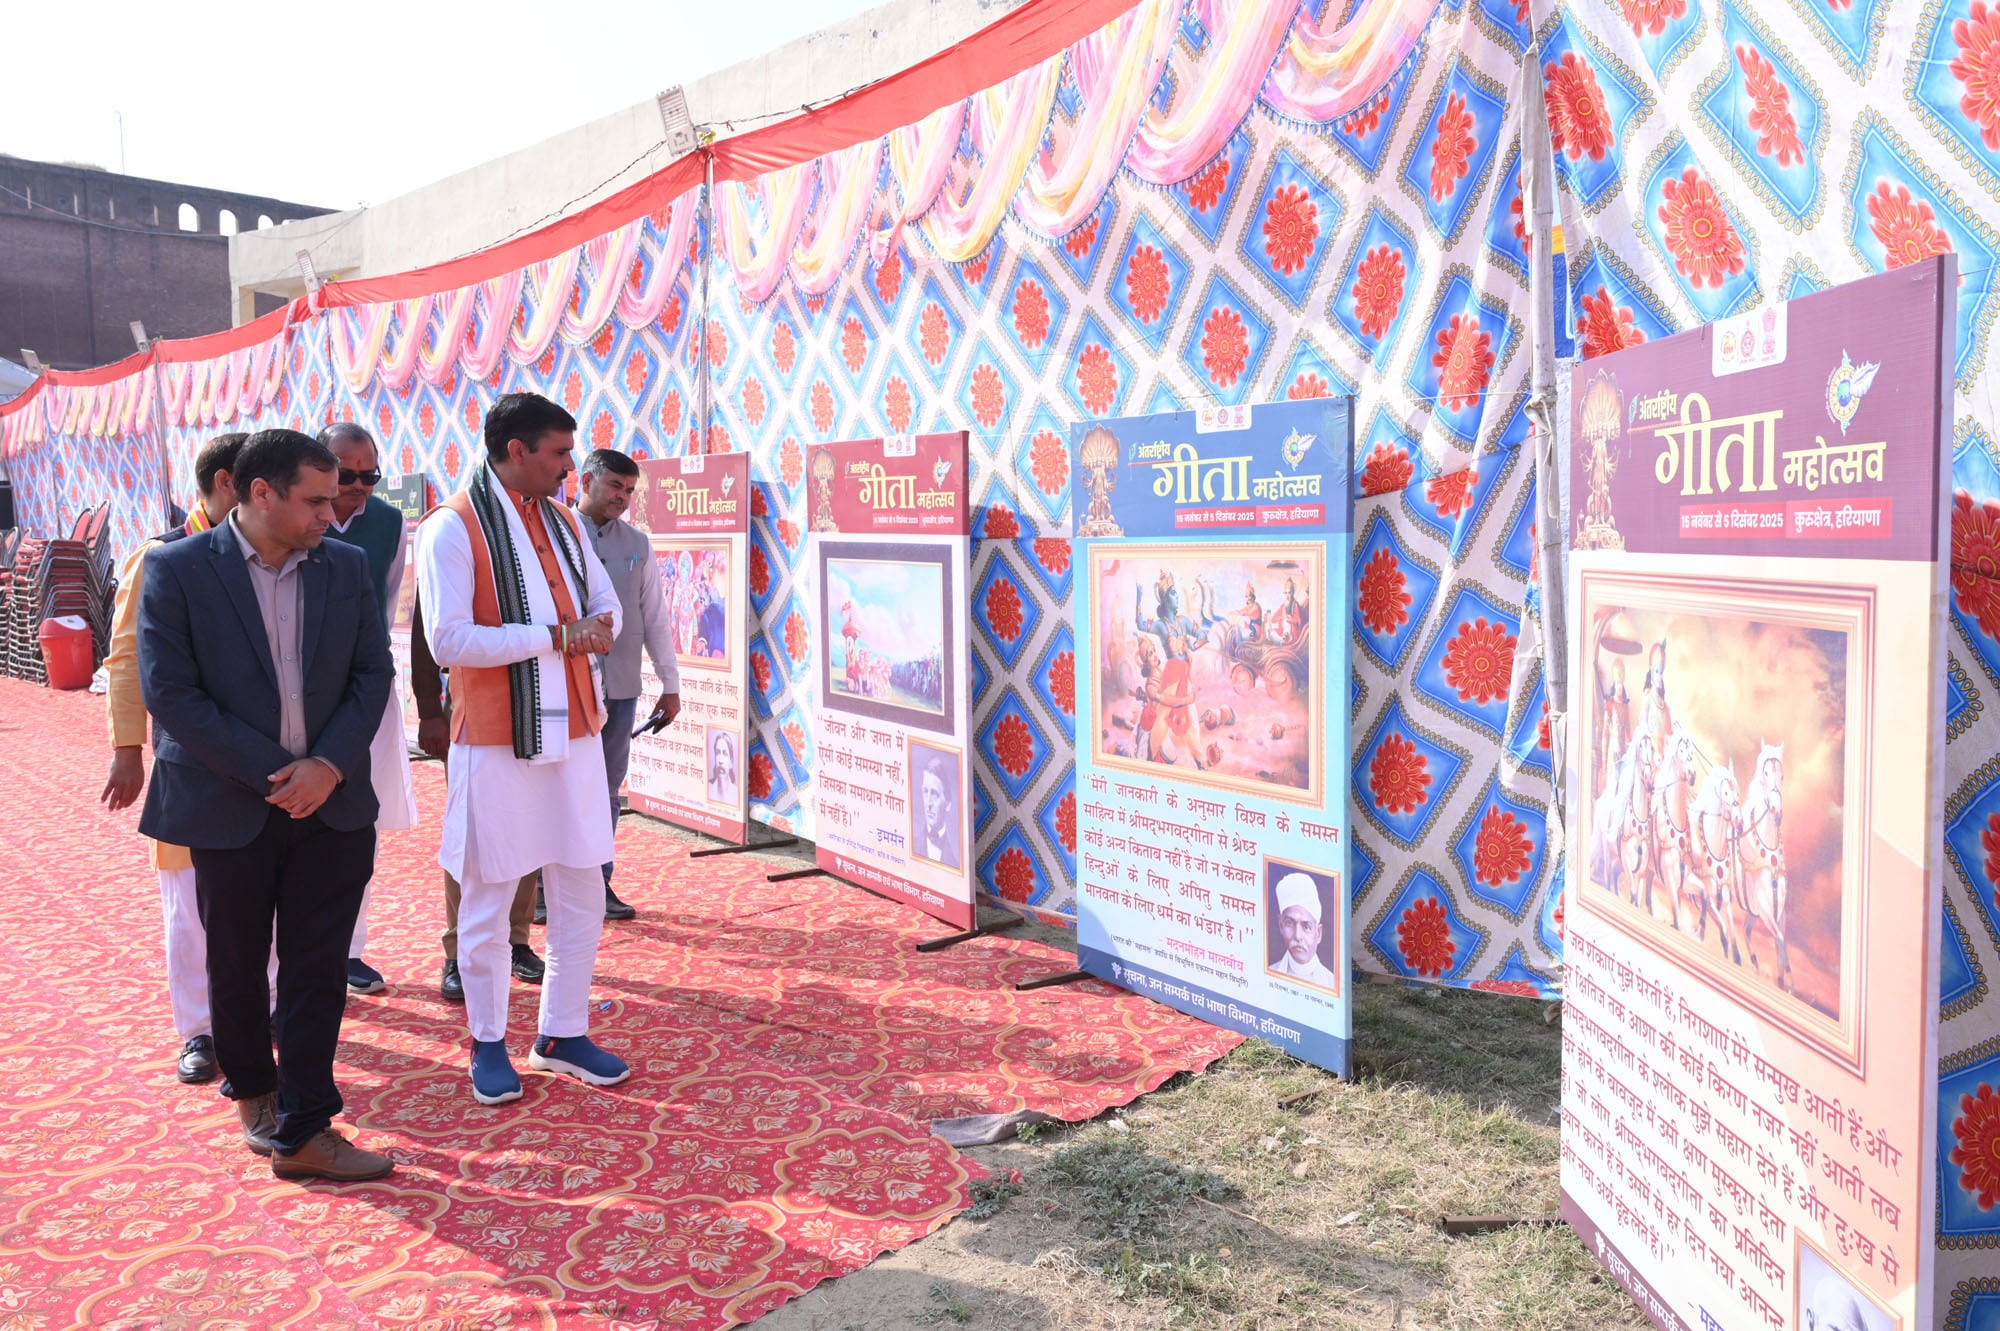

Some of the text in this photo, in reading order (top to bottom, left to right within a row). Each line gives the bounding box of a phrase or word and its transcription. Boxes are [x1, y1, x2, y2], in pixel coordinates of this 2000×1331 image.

[1151, 443, 1322, 503] गीता महोत्सव
[1654, 392, 1784, 496] गीता
[1782, 435, 1887, 492] महोत्सव
[666, 479, 710, 515] गीता
[709, 497, 737, 515] महोत्सव
[858, 464, 955, 510] गीता महोत्सव
[1237, 507, 1319, 520] 2025 हरियाणा
[1681, 514, 1690, 529] 15
[1691, 511, 1713, 529] नवंबर
[1714, 510, 1722, 528] से
[1723, 514, 1729, 528] 5
[1731, 508, 1758, 529] दिसंबर
[1760, 513, 1784, 528] 2025
[1835, 504, 1881, 529] हरियाणा
[699, 678, 713, 694] जाति
[715, 679, 722, 694] के
[724, 680, 739, 701] लिए
[706, 704, 719, 719] एक
[691, 720, 704, 740] लिए
[818, 740, 834, 766] ऐसी
[835, 746, 853, 772] कोई
[854, 755, 883, 777] समस्या
[851, 720, 905, 752] और जगत में
[690, 763, 704, 785] लिए
[819, 770, 904, 814] जिसका समाधान गीता
[819, 798, 841, 825] में नहीं
[1083, 801, 1257, 856] साहित्य में श्रीमद्भगवद्गीता से श्रेष्ठ
[1114, 784, 1339, 844] जानकारी के अनुसार विश्व के समस्त
[1084, 826, 1256, 887] कोई अन्य किताब नहीं है जो न केवल
[1084, 852, 1256, 917] हिन्दुओं के लिए अपितु समस्त
[1084, 882, 1235, 943] मानवता के लिए धर्म का भंडार है
[1166, 937, 1205, 963] मदनमोहन
[1207, 951, 1244, 972] मालवीय
[1123, 967, 1301, 1044] सूचना, जन सम्पर्क एवं भाषा विभाग, हरियाणा
[1586, 939, 1902, 1177] शंकाएं मुझे घेरती हैं, निराशाएं मेरे सन्मुख आती हैं और
[1575, 965, 1605, 1008] क्षितिज
[1608, 994, 1625, 1023] तक
[1629, 1010, 1656, 1047] आशा
[1659, 1031, 1676, 1061] की
[1679, 1045, 1704, 1088] कोई
[1707, 1061, 1748, 1116] किरण
[1751, 1099, 1785, 1144] नजर
[1788, 1127, 1818, 1169] नहीं
[1821, 1153, 1865, 1204] आती
[1868, 1187, 1902, 1233] तब
[1577, 1042, 1593, 1074] होने
[1594, 1057, 1606, 1085] के
[1607, 1071, 1644, 1123] बावजूद
[1646, 1099, 1657, 1128] मैं
[1657, 1114, 1679, 1150] उसी
[1683, 1138, 1708, 1174] क्षण
[1710, 1160, 1755, 1216] मुस्कुरा
[1758, 1193, 1786, 1244] देता
[1637, 1053, 1650, 1083] के
[1652, 1069, 1687, 1113] श्लोक
[1689, 1101, 1711, 1136] मुझे
[1714, 1118, 1752, 1167] सहारा
[1755, 1144, 1778, 1188] देते
[1781, 1163, 1795, 1205] हैं
[1798, 1184, 1830, 1231] और
[1880, 1244, 1900, 1287] से
[1561, 1139, 1576, 1170] और
[1577, 1156, 1594, 1188] नया
[1597, 1176, 1613, 1209] अर्थ
[1629, 1208, 1648, 1246] लेते
[1561, 1105, 1580, 1137] ध्यान
[1583, 1125, 1604, 1161] करते
[1606, 1140, 1615, 1173] हैं
[1616, 1151, 1624, 1181] वे
[1626, 1168, 1651, 1206] उसमें
[1653, 1188, 1664, 1220] से
[1666, 1206, 1681, 1237] हर
[1684, 1217, 1706, 1262] दिन
[1709, 1247, 1735, 1290] नया
[1575, 1080, 1785, 1292] जो लोग श्रीमद्भगवद्गीता का प्रतिदिन
[1606, 1246, 1632, 1289] सूचना,
[1633, 1276, 1648, 1304] जन
